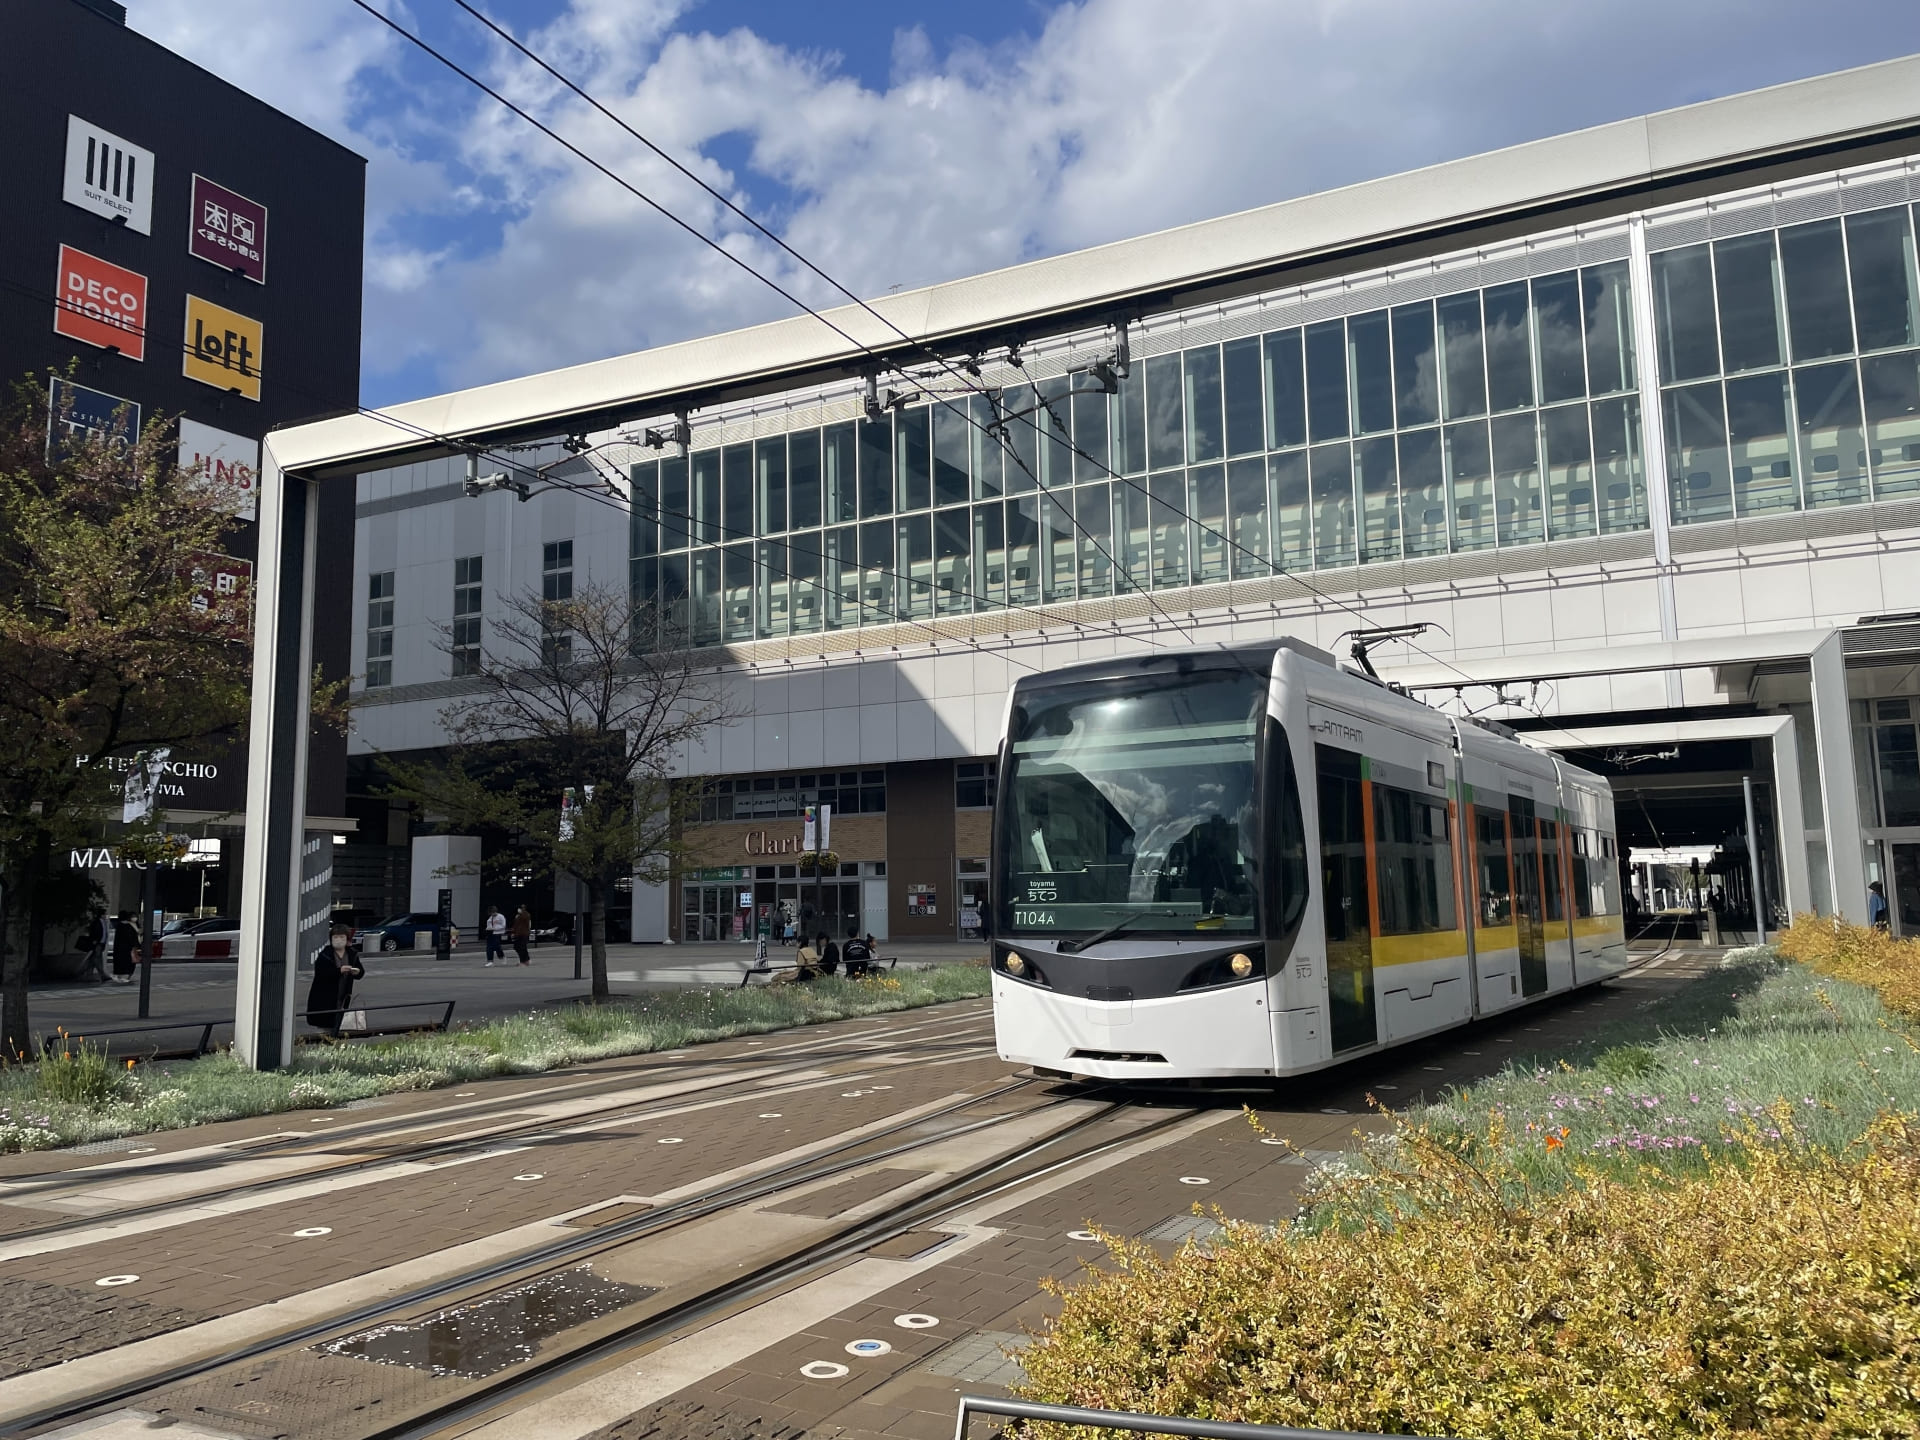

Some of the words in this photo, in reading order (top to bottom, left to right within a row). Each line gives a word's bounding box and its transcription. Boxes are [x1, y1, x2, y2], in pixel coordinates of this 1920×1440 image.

[84, 189, 101, 201] SUIT
[103, 198, 132, 215] SELECT
[68, 271, 138, 311] DECO
[66, 294, 136, 333] HOME
[745, 831, 806, 856] Clart
[1027, 890, 1058, 902] ちてつ
[1015, 911, 1055, 925] T104A
